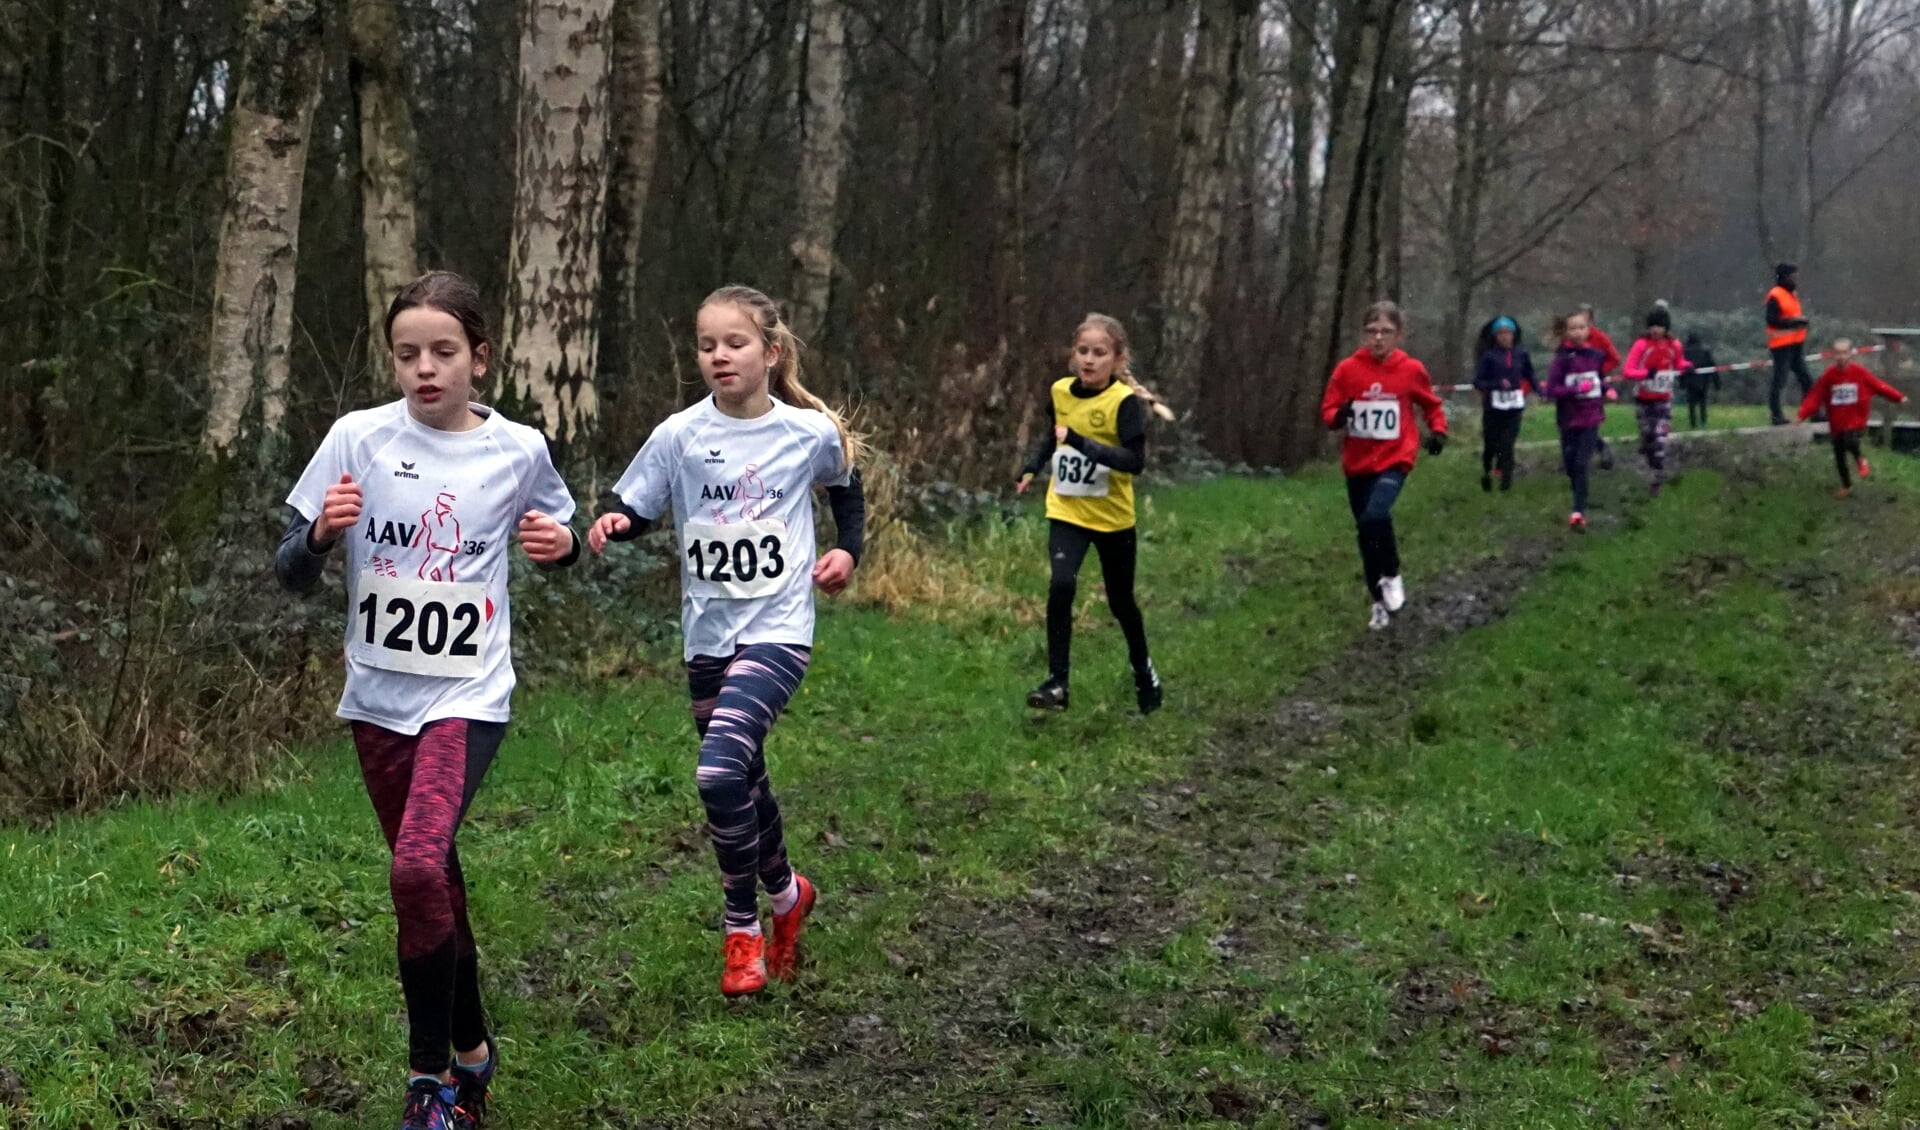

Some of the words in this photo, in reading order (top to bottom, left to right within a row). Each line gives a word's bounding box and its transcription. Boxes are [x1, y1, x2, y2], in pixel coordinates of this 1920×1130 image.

[394, 471, 419, 479] erima
[1058, 454, 1097, 485] 632
[701, 484, 736, 501] AAV
[365, 516, 417, 548] AAV
[688, 534, 785, 583] 1203
[359, 592, 480, 656] 1202
